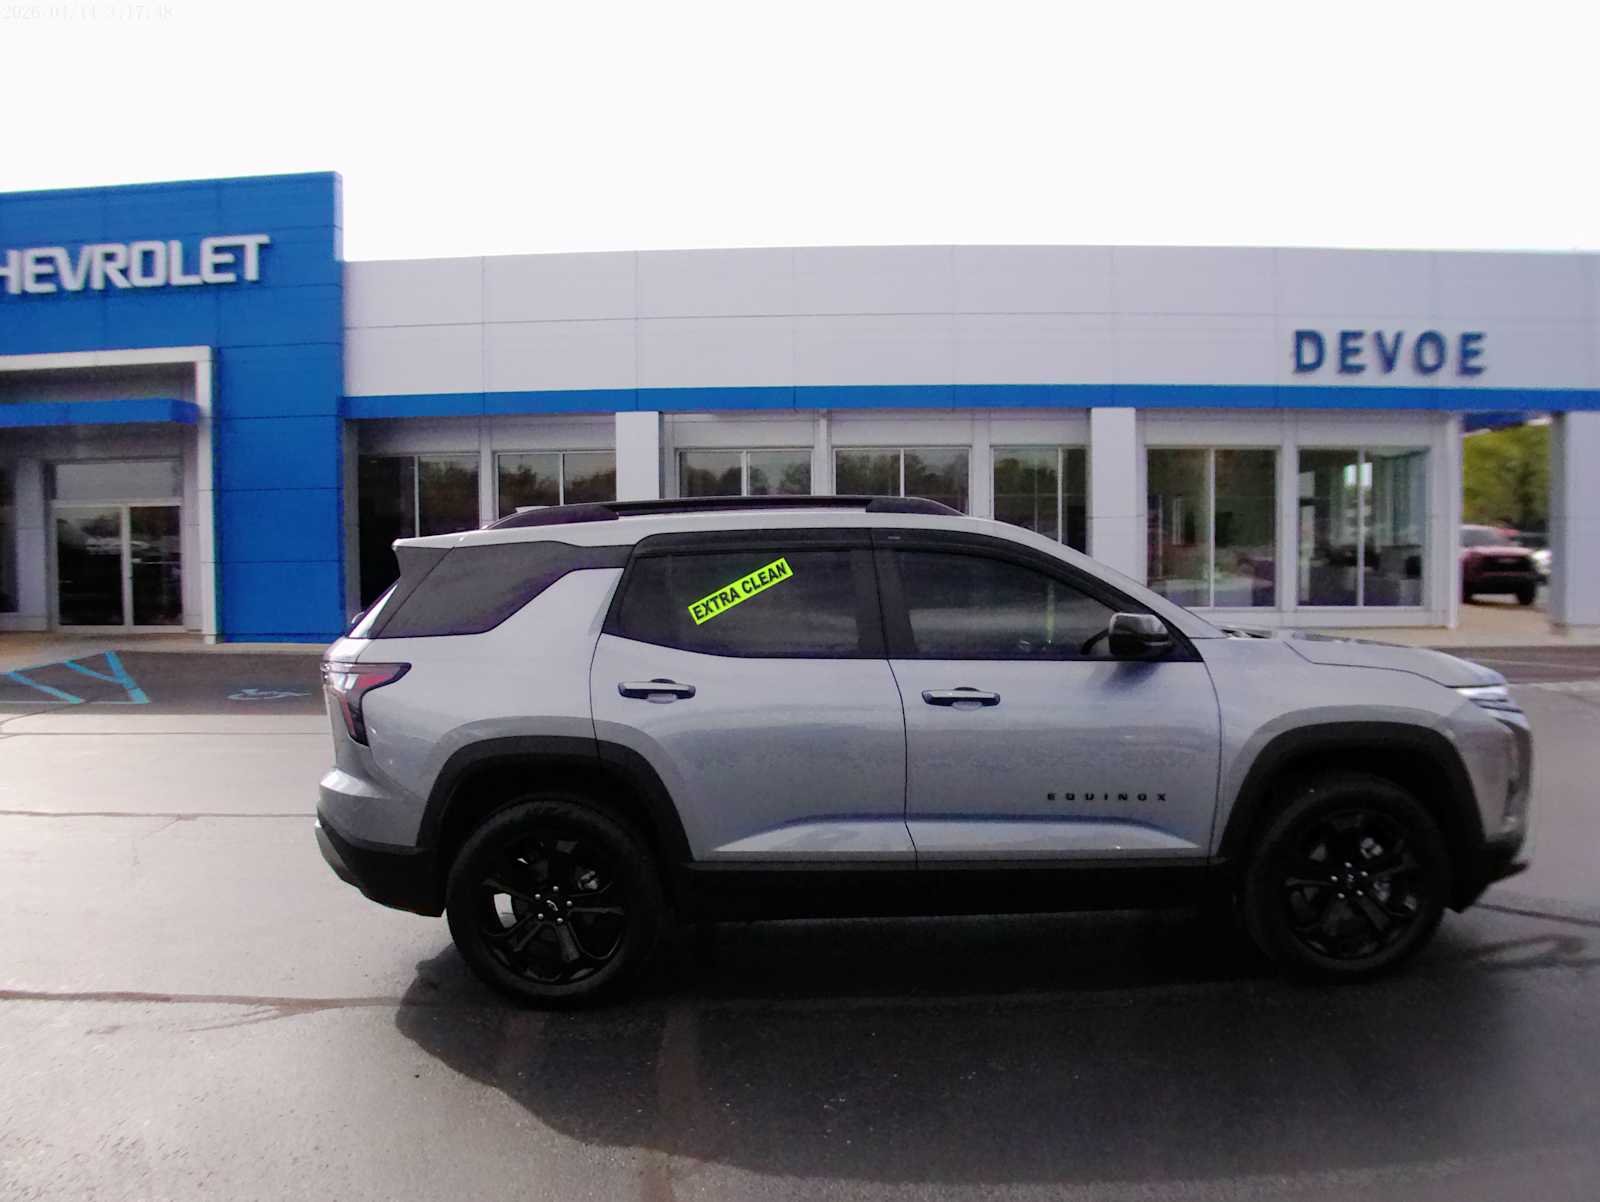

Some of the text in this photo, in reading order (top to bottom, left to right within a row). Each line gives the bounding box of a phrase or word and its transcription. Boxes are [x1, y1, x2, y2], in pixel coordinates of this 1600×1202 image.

[1293, 329, 1488, 376] DEVOE
[692, 562, 787, 620] EXTRA CLEAN
[1047, 792, 1167, 802] EQUINOX
